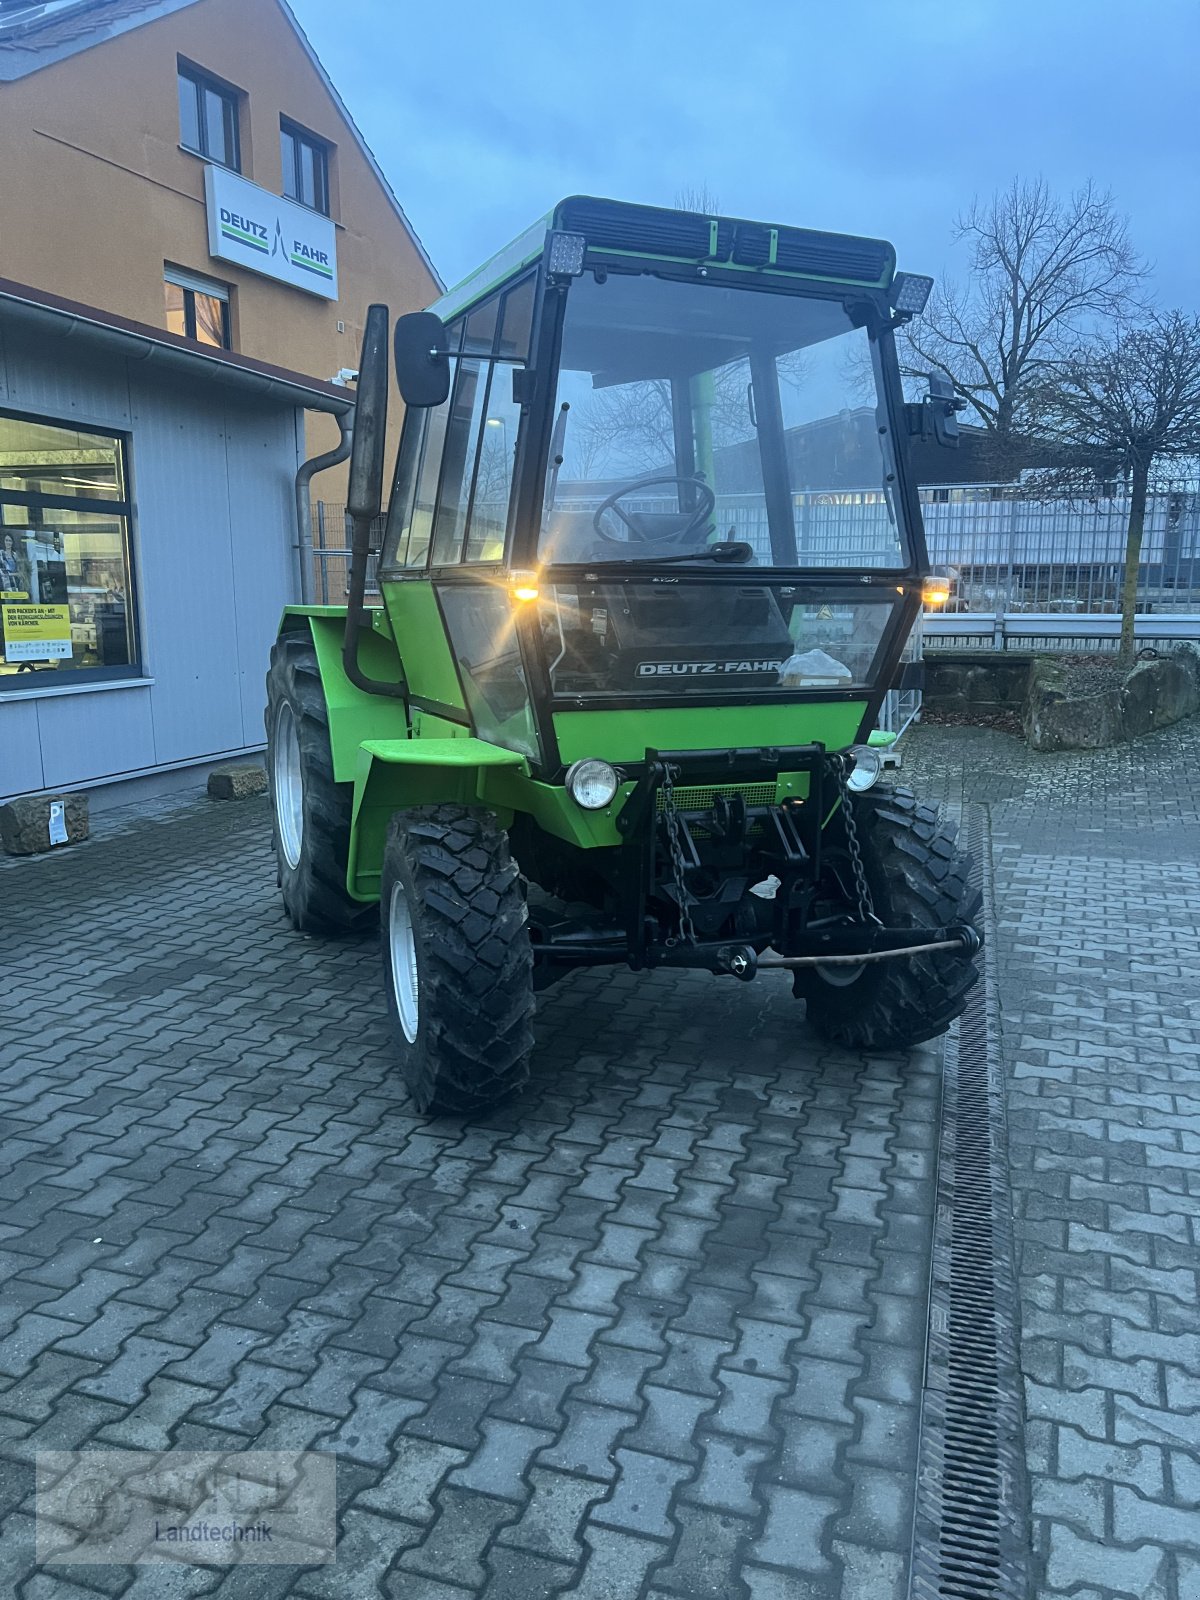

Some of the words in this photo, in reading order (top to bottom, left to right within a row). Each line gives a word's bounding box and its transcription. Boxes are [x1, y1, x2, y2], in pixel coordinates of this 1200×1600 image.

[220, 207, 268, 240] DEUTZ
[293, 239, 328, 266] FAHR
[639, 661, 782, 675] DEUTZ-FAHR
